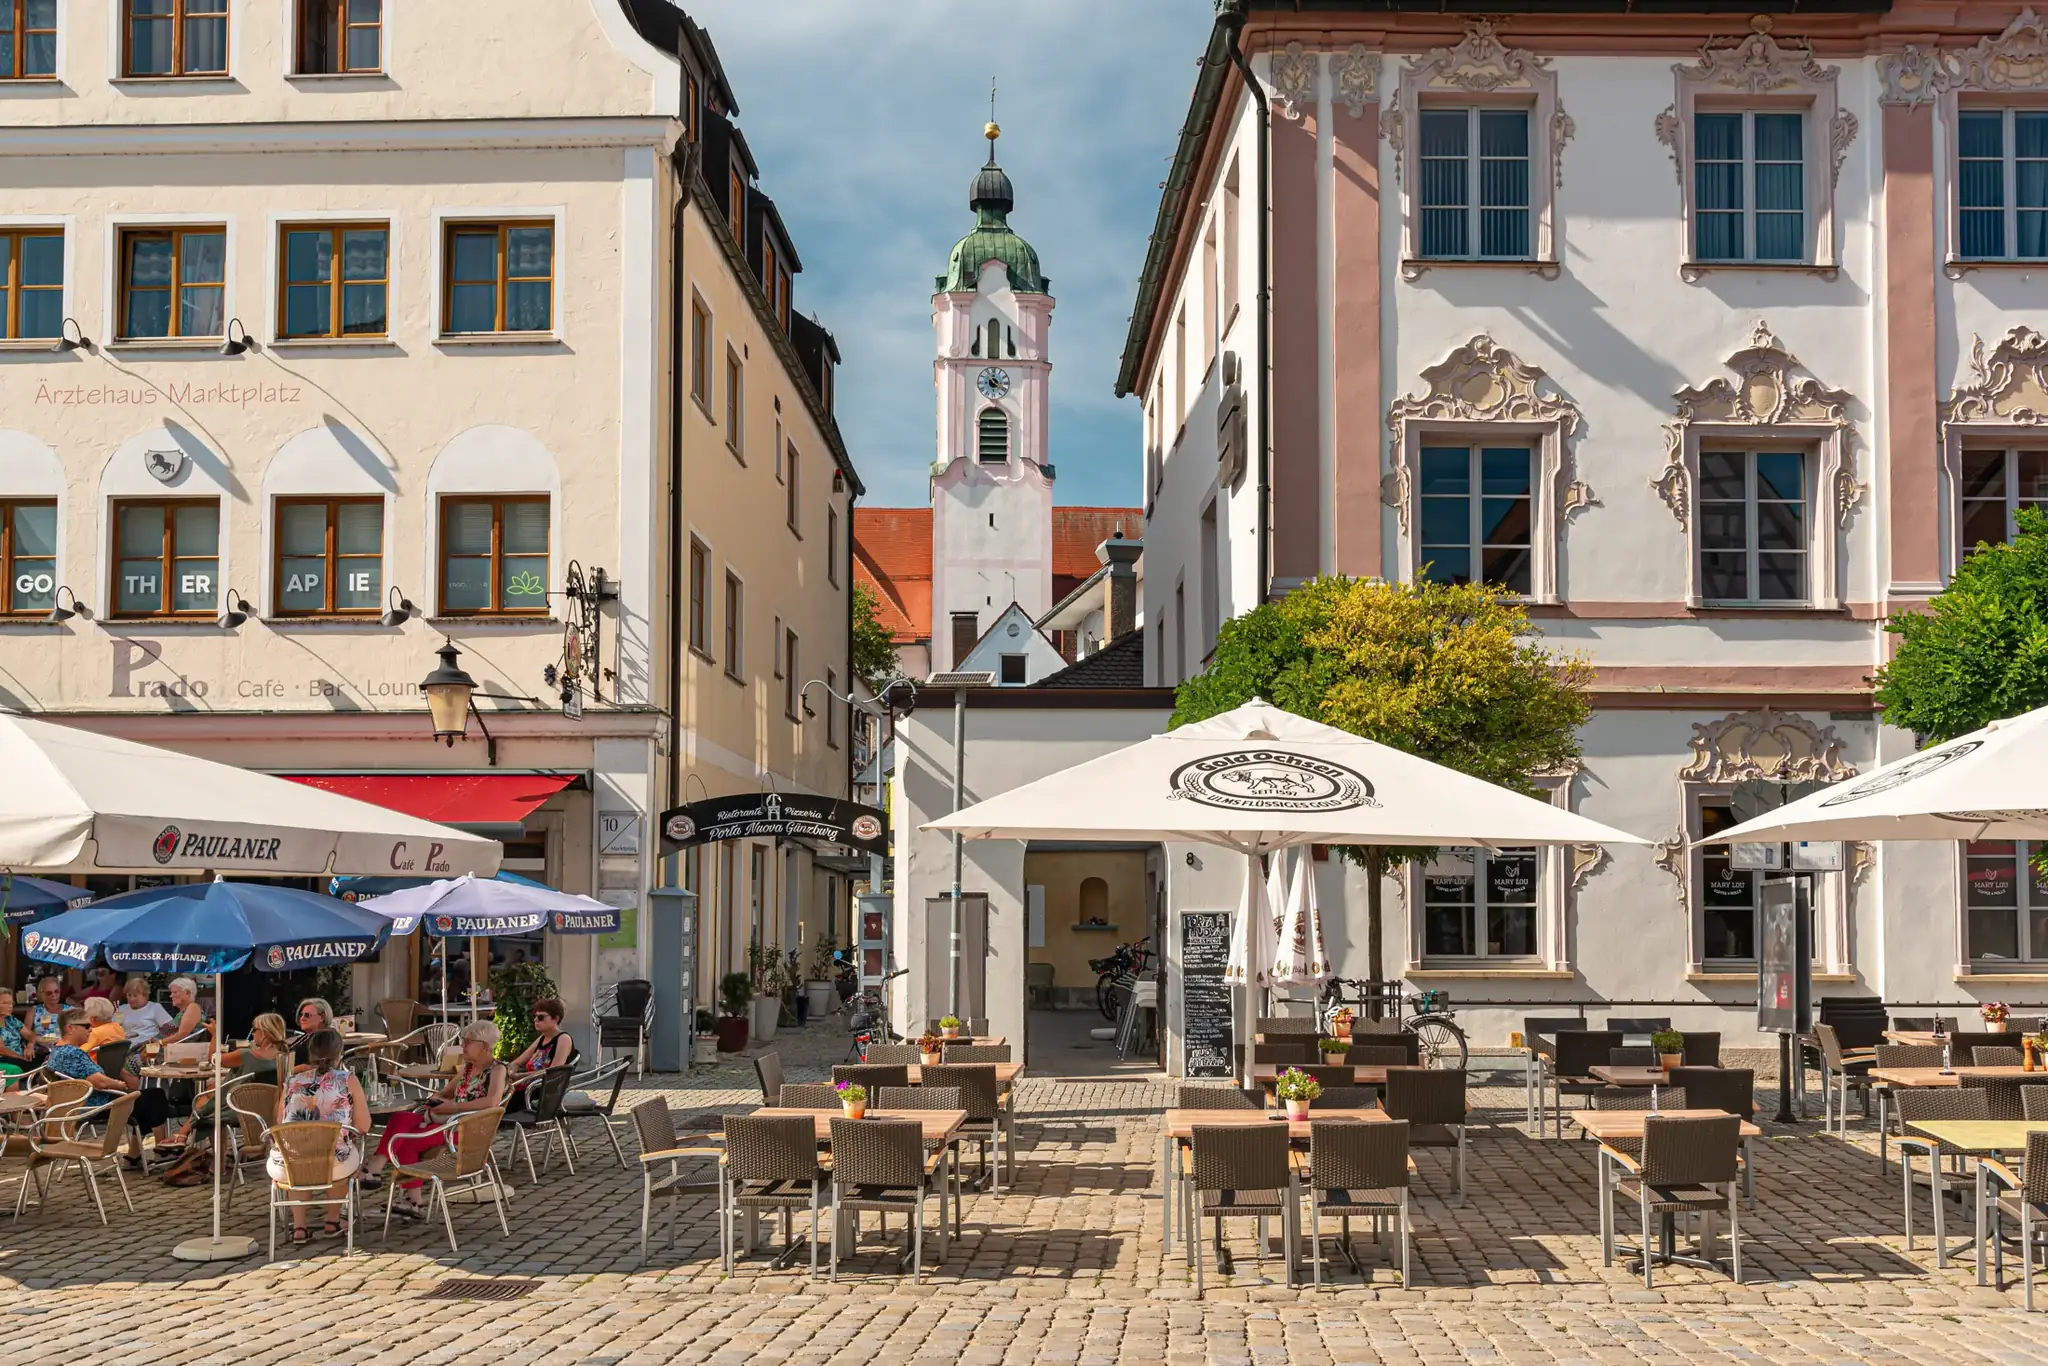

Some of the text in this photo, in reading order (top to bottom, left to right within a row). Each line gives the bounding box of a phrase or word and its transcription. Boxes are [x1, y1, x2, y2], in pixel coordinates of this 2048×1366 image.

[34, 378, 301, 409] Ärztehaus Marktplatz
[16, 573, 370, 593] GO TH ER AP IE
[108, 640, 208, 698] Prado
[237, 679, 285, 697] Café
[309, 680, 345, 697] Bar
[1195, 753, 1345, 777] Gold Ochsen
[1207, 794, 1343, 808] ULMS FLÜSSIGES GOLD
[1251, 788, 1298, 797] SEIT 1597
[717, 806, 823, 821] Ristorante Pizzeria
[603, 817, 618, 832] 10
[709, 825, 742, 842] Porta
[745, 821, 783, 835] Nuova
[786, 821, 839, 842] Günzburg
[180, 833, 282, 860] PAULANER
[390, 841, 450, 872] Café Prado
[1186, 852, 1195, 866] 8
[456, 914, 540, 931] PAULANER
[564, 914, 616, 928] PAULANER
[164, 953, 209, 963] PAULANER.
